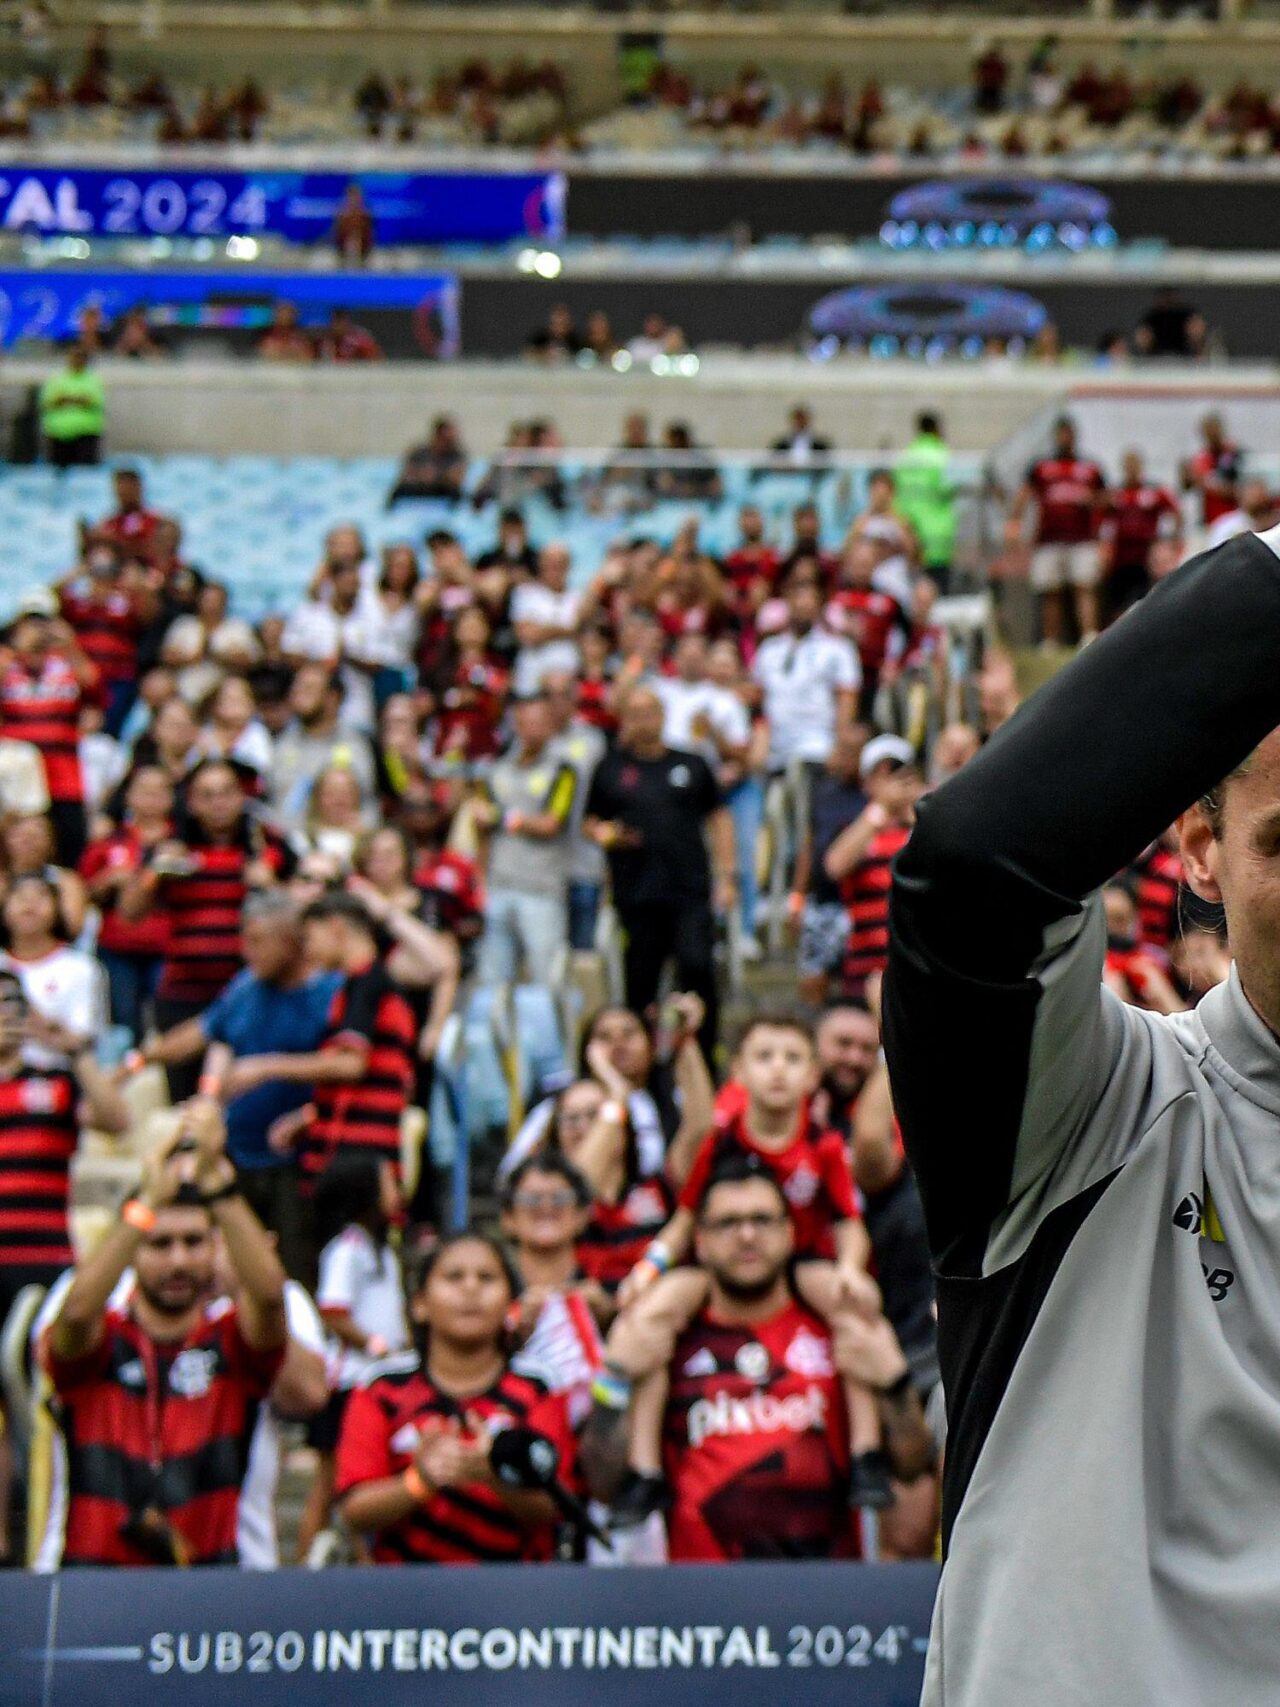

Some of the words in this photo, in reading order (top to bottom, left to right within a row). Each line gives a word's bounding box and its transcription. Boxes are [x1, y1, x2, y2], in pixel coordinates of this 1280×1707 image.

[103, 179, 268, 234] 2024
[687, 1384, 826, 1448] pixbet
[149, 1630, 305, 1674] SUB20
[312, 1628, 782, 1673] INTERCONTINENTAL
[787, 1624, 902, 1668] 2024
